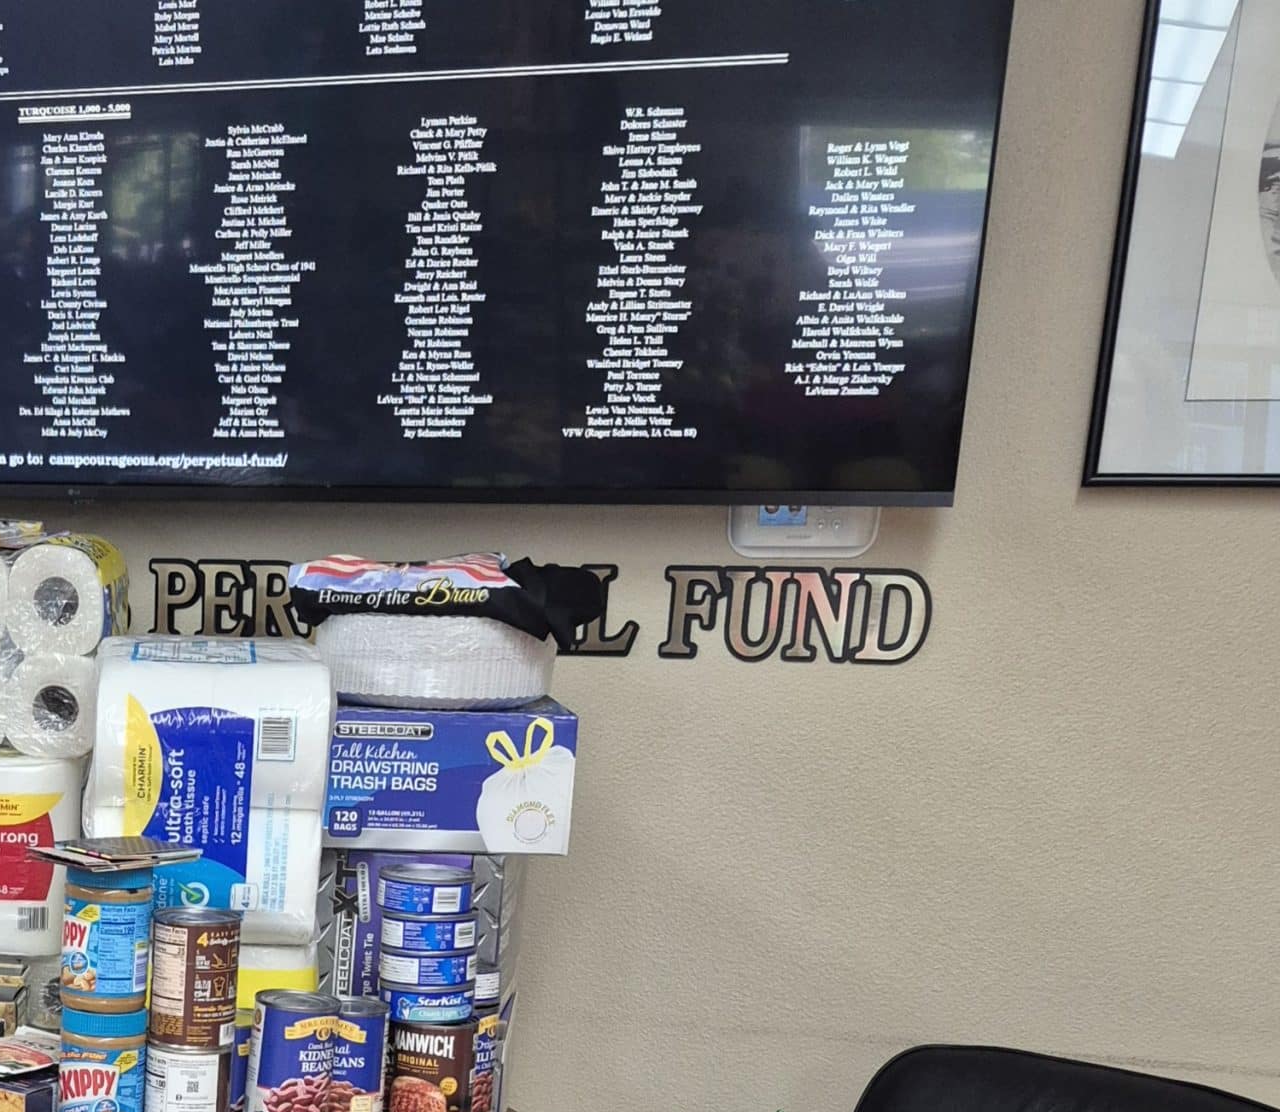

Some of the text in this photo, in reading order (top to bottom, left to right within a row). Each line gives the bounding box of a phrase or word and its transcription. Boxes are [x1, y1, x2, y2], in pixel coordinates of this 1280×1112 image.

[19, 106, 76, 117] TURQUOISE
[9, 455, 24, 467] go
[27, 453, 44, 465] to:
[318, 577, 492, 608] Home of the Brave
[664, 565, 932, 664] FUND
[339, 724, 425, 737] STEELCOAT
[332, 743, 417, 761] Tall Kitchen
[136, 745, 147, 799] CHARMIN
[235, 762, 246, 779] 48
[331, 759, 439, 776] DRAWSTRING
[331, 775, 437, 792] TRASH BAGS
[164, 748, 185, 844] ultra-soft
[183, 769, 197, 844] bath tissue
[335, 810, 358, 822] 120
[333, 822, 357, 832] BAGS
[231, 831, 241, 844] 12
[63, 921, 87, 948] PPY
[197, 932, 210, 948] 4
[363, 932, 374, 950] Tie
[417, 995, 462, 1007] StarKist
[333, 1056, 365, 1069] EANS
